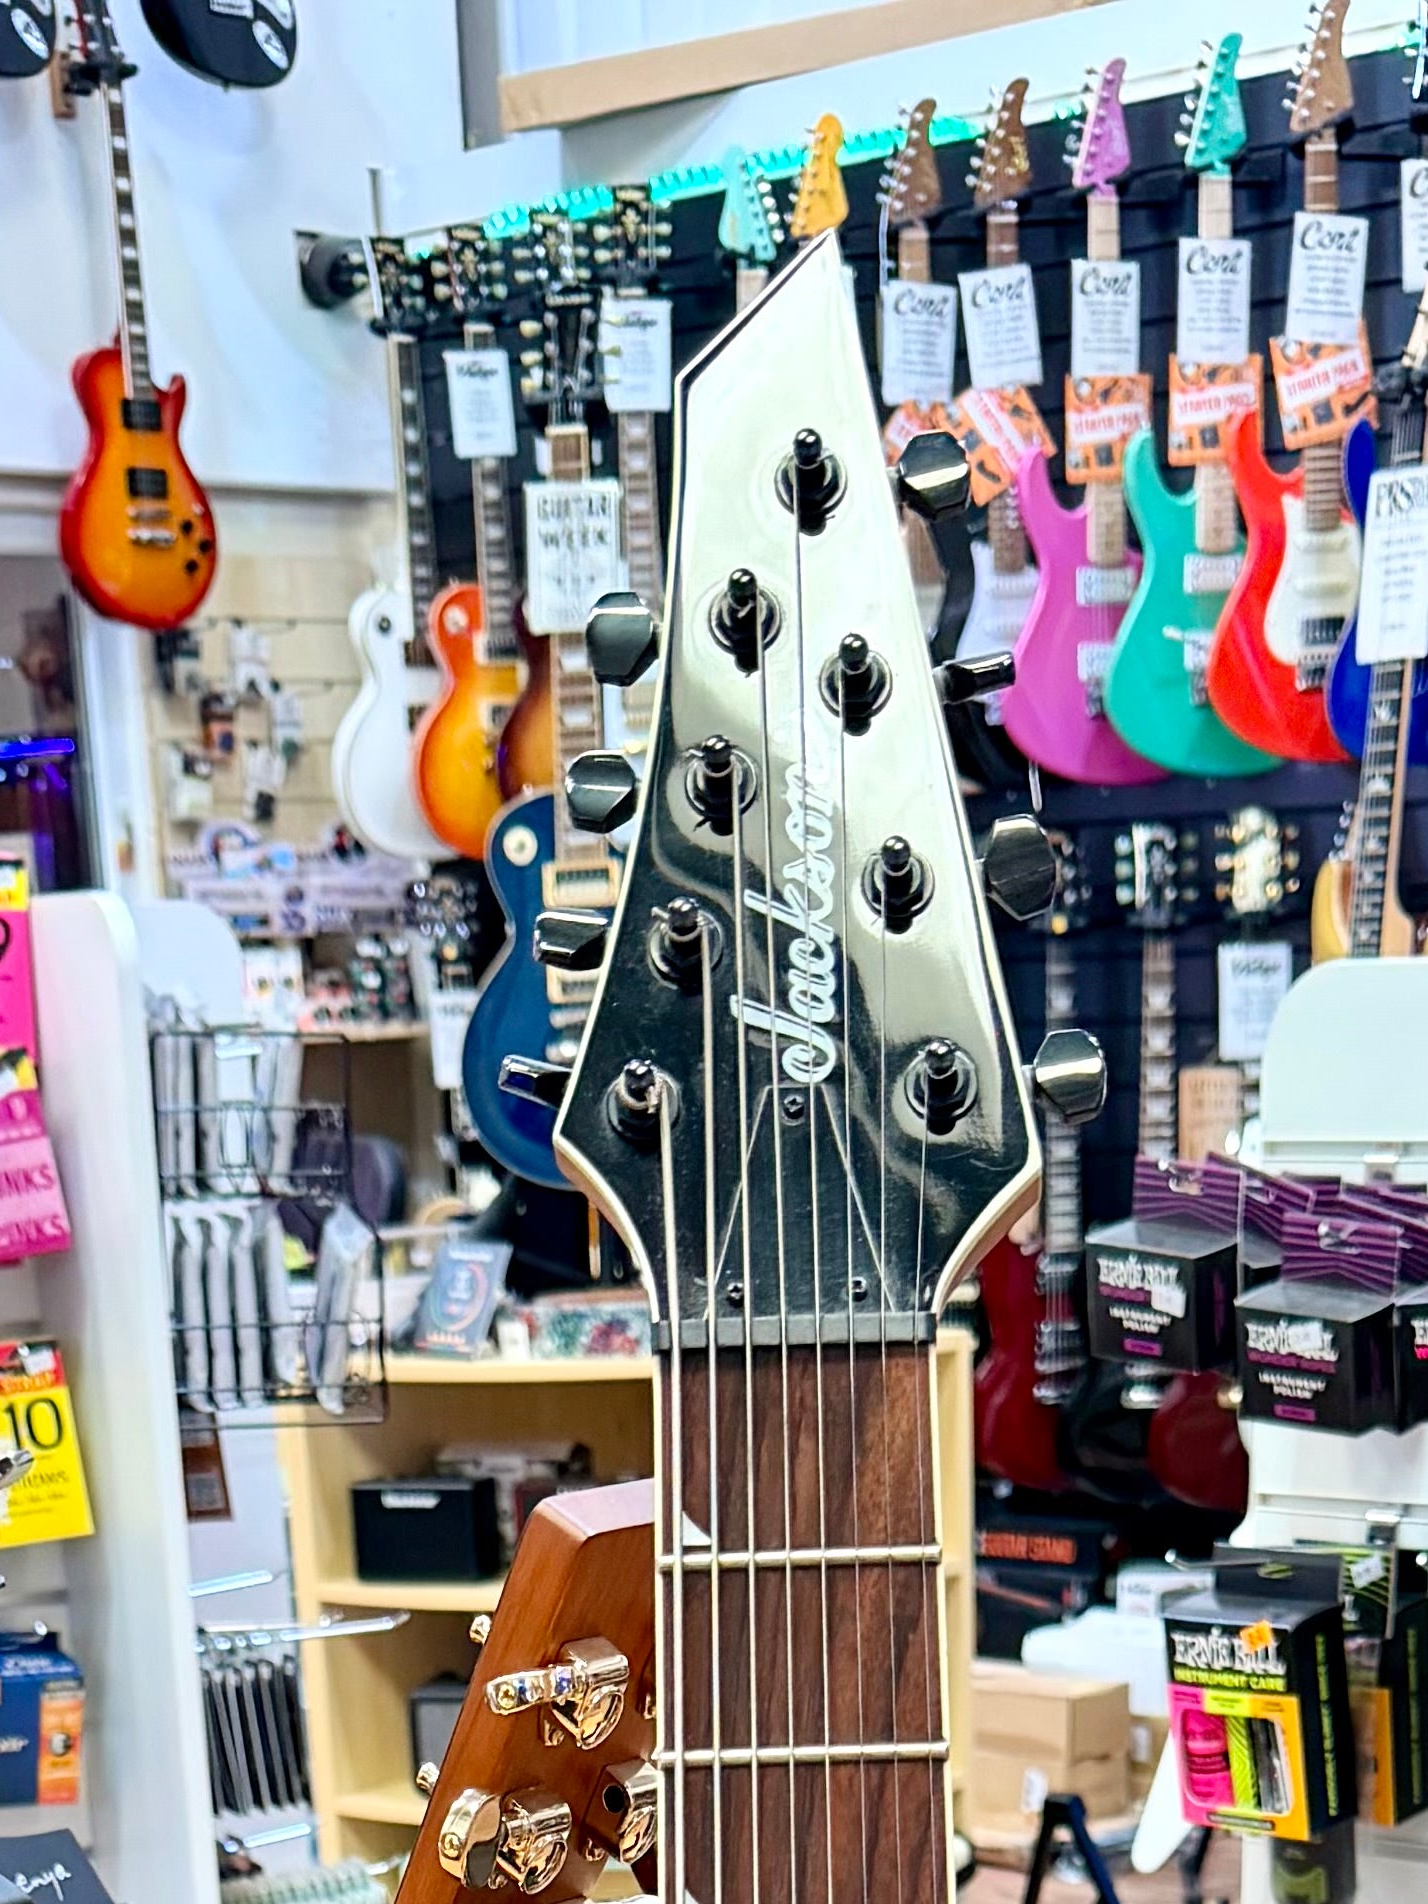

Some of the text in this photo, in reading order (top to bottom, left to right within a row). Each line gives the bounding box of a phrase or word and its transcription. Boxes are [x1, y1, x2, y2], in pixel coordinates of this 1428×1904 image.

[1300, 220, 1360, 252] Cort
[1185, 245, 1243, 276] Cort
[729, 703, 837, 1085] Jackson
[3, 1398, 63, 1451] 10
[1171, 1624, 1232, 1669] ERNIE
[1173, 1665, 1248, 1689] INSTRUMENT
